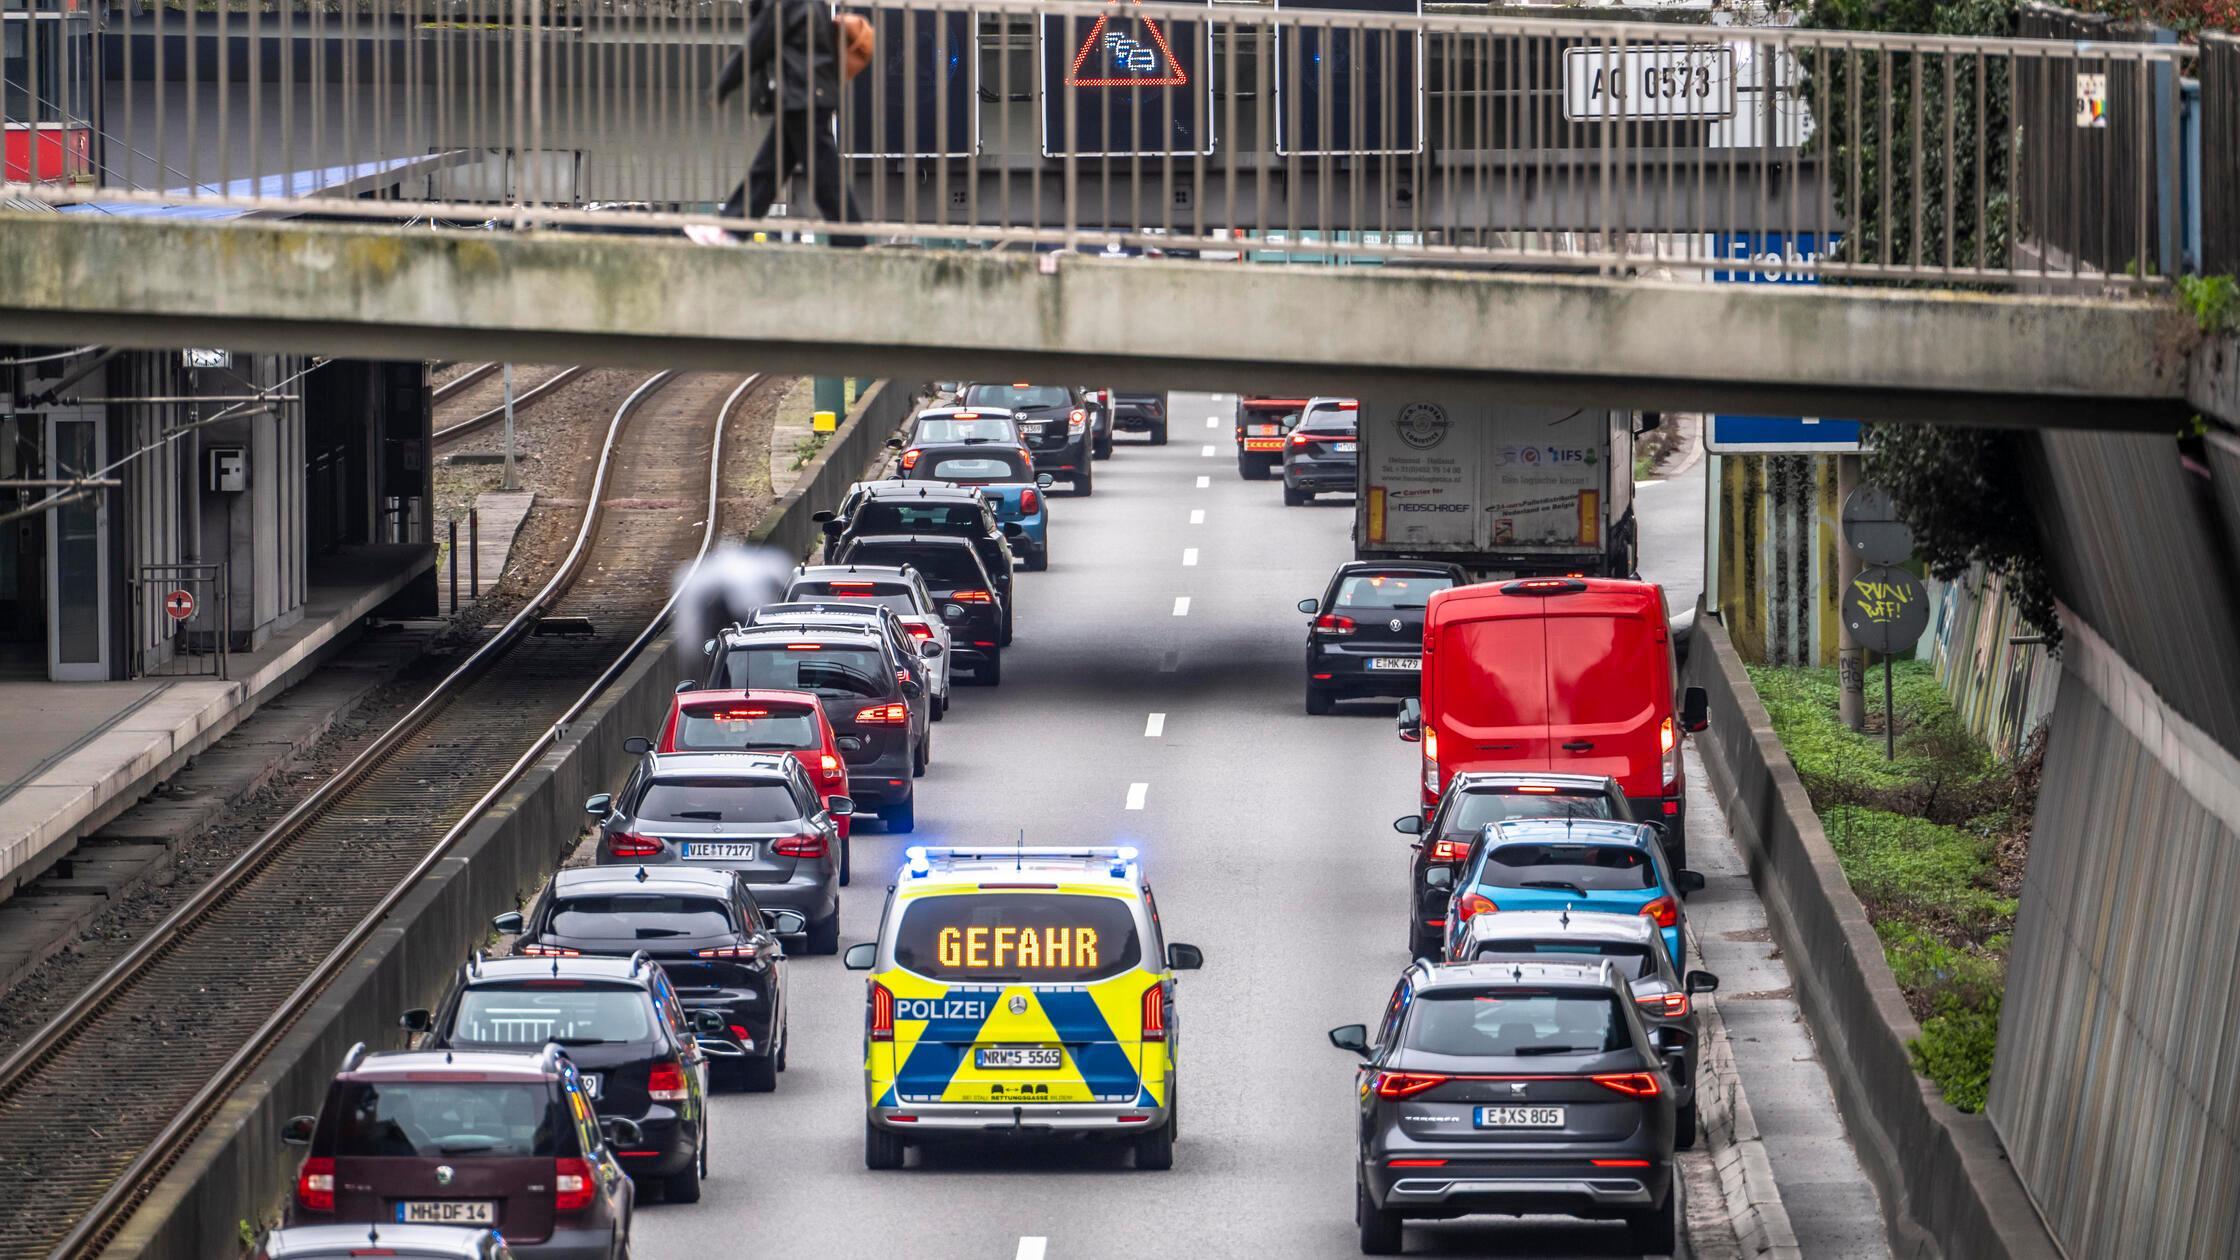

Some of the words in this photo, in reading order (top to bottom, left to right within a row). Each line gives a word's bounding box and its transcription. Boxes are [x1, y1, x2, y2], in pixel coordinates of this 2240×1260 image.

[1644, 67, 1710, 99] 0573
[1561, 450, 1582, 461] IFS
[1401, 659, 1418, 668] 479
[690, 844, 709, 856] VIE
[717, 844, 724, 856] T
[726, 844, 752, 856] 7177
[938, 926, 1099, 968] GEFAHR
[896, 999, 985, 1020] POLIZEI
[983, 1050, 1007, 1064] NRW
[1488, 1109, 1497, 1124] E
[1508, 1109, 1527, 1124] XS
[1530, 1109, 1558, 1124] 805
[411, 1204, 432, 1219] MH
[443, 1204, 462, 1219] DF
[466, 1204, 486, 1220] 14
